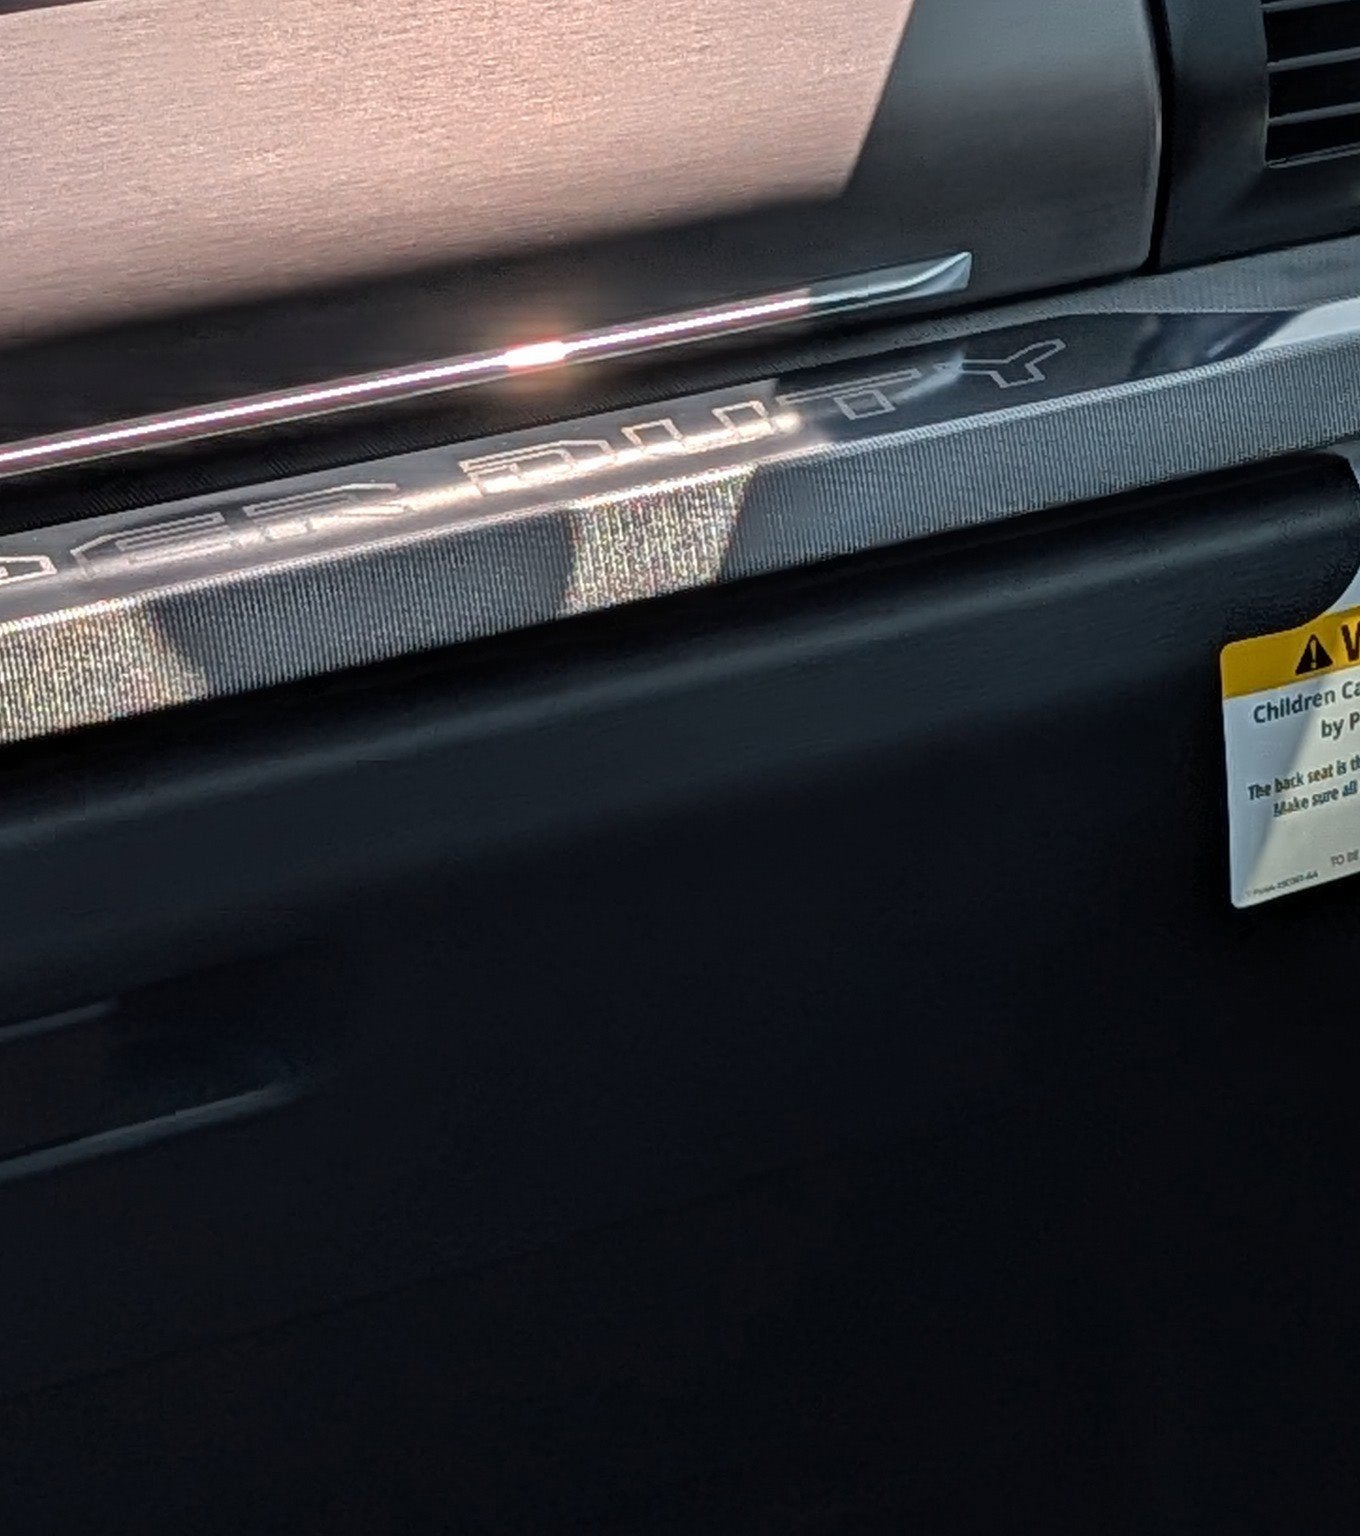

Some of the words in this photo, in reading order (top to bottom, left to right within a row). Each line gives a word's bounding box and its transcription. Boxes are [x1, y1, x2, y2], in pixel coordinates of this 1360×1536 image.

[458, 339, 1067, 498] DUTY
[1253, 690, 1335, 723] Children
[1321, 718, 1344, 739] by
[1248, 783, 1271, 800] The
[1274, 772, 1304, 793] back
[1307, 764, 1333, 783] seat
[1336, 760, 1347, 775] is
[1273, 796, 1309, 817] Make
[1312, 787, 1339, 806] sure
[1342, 780, 1357, 796] all
